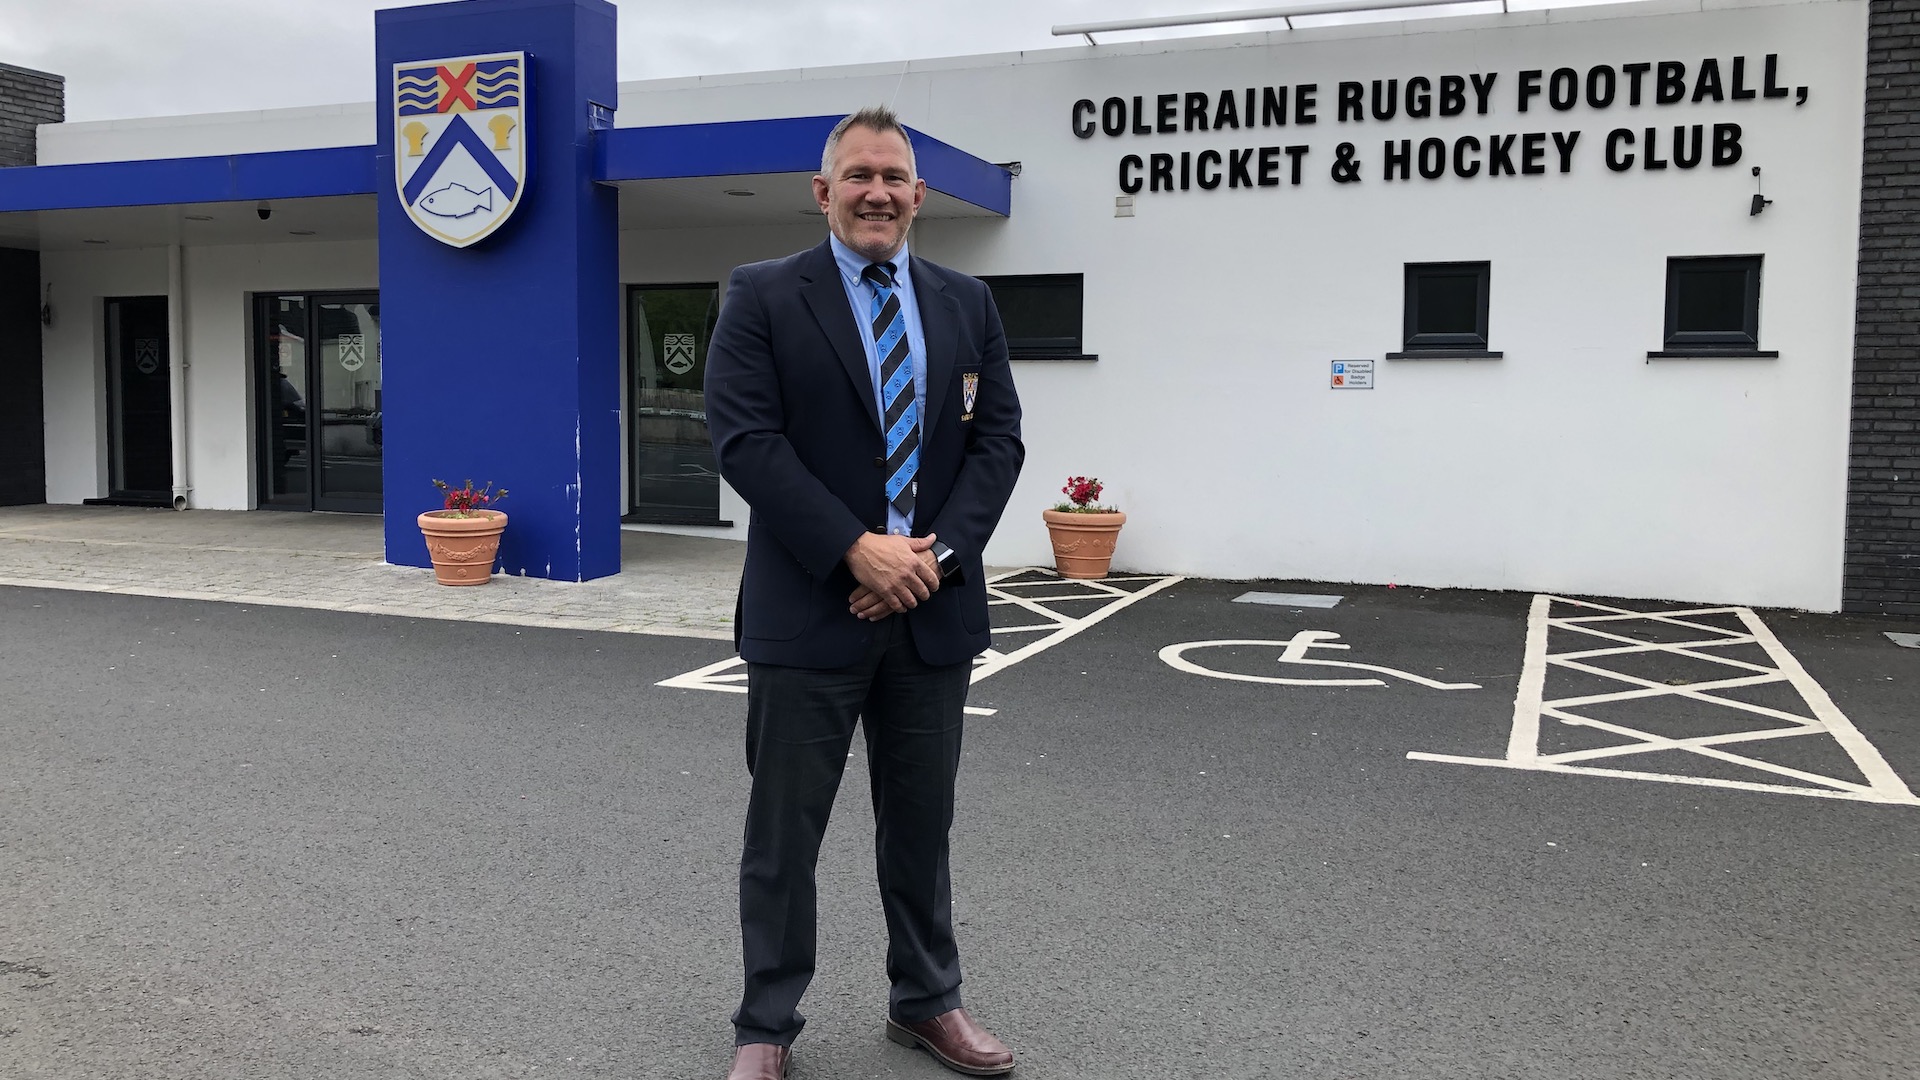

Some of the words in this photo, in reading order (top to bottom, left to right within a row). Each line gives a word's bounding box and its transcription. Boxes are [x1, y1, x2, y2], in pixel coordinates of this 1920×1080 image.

[1072, 83, 1318, 140] COLERAINE
[1337, 72, 1498, 123] RUGBY
[1517, 53, 1809, 114] FOOTBALL,
[1119, 144, 1310, 196] CRICKET
[1330, 141, 1362, 185] &
[1383, 130, 1581, 182] HOCKEY
[1605, 122, 1743, 173] CLUB
[1336, 364, 1342, 373] P
